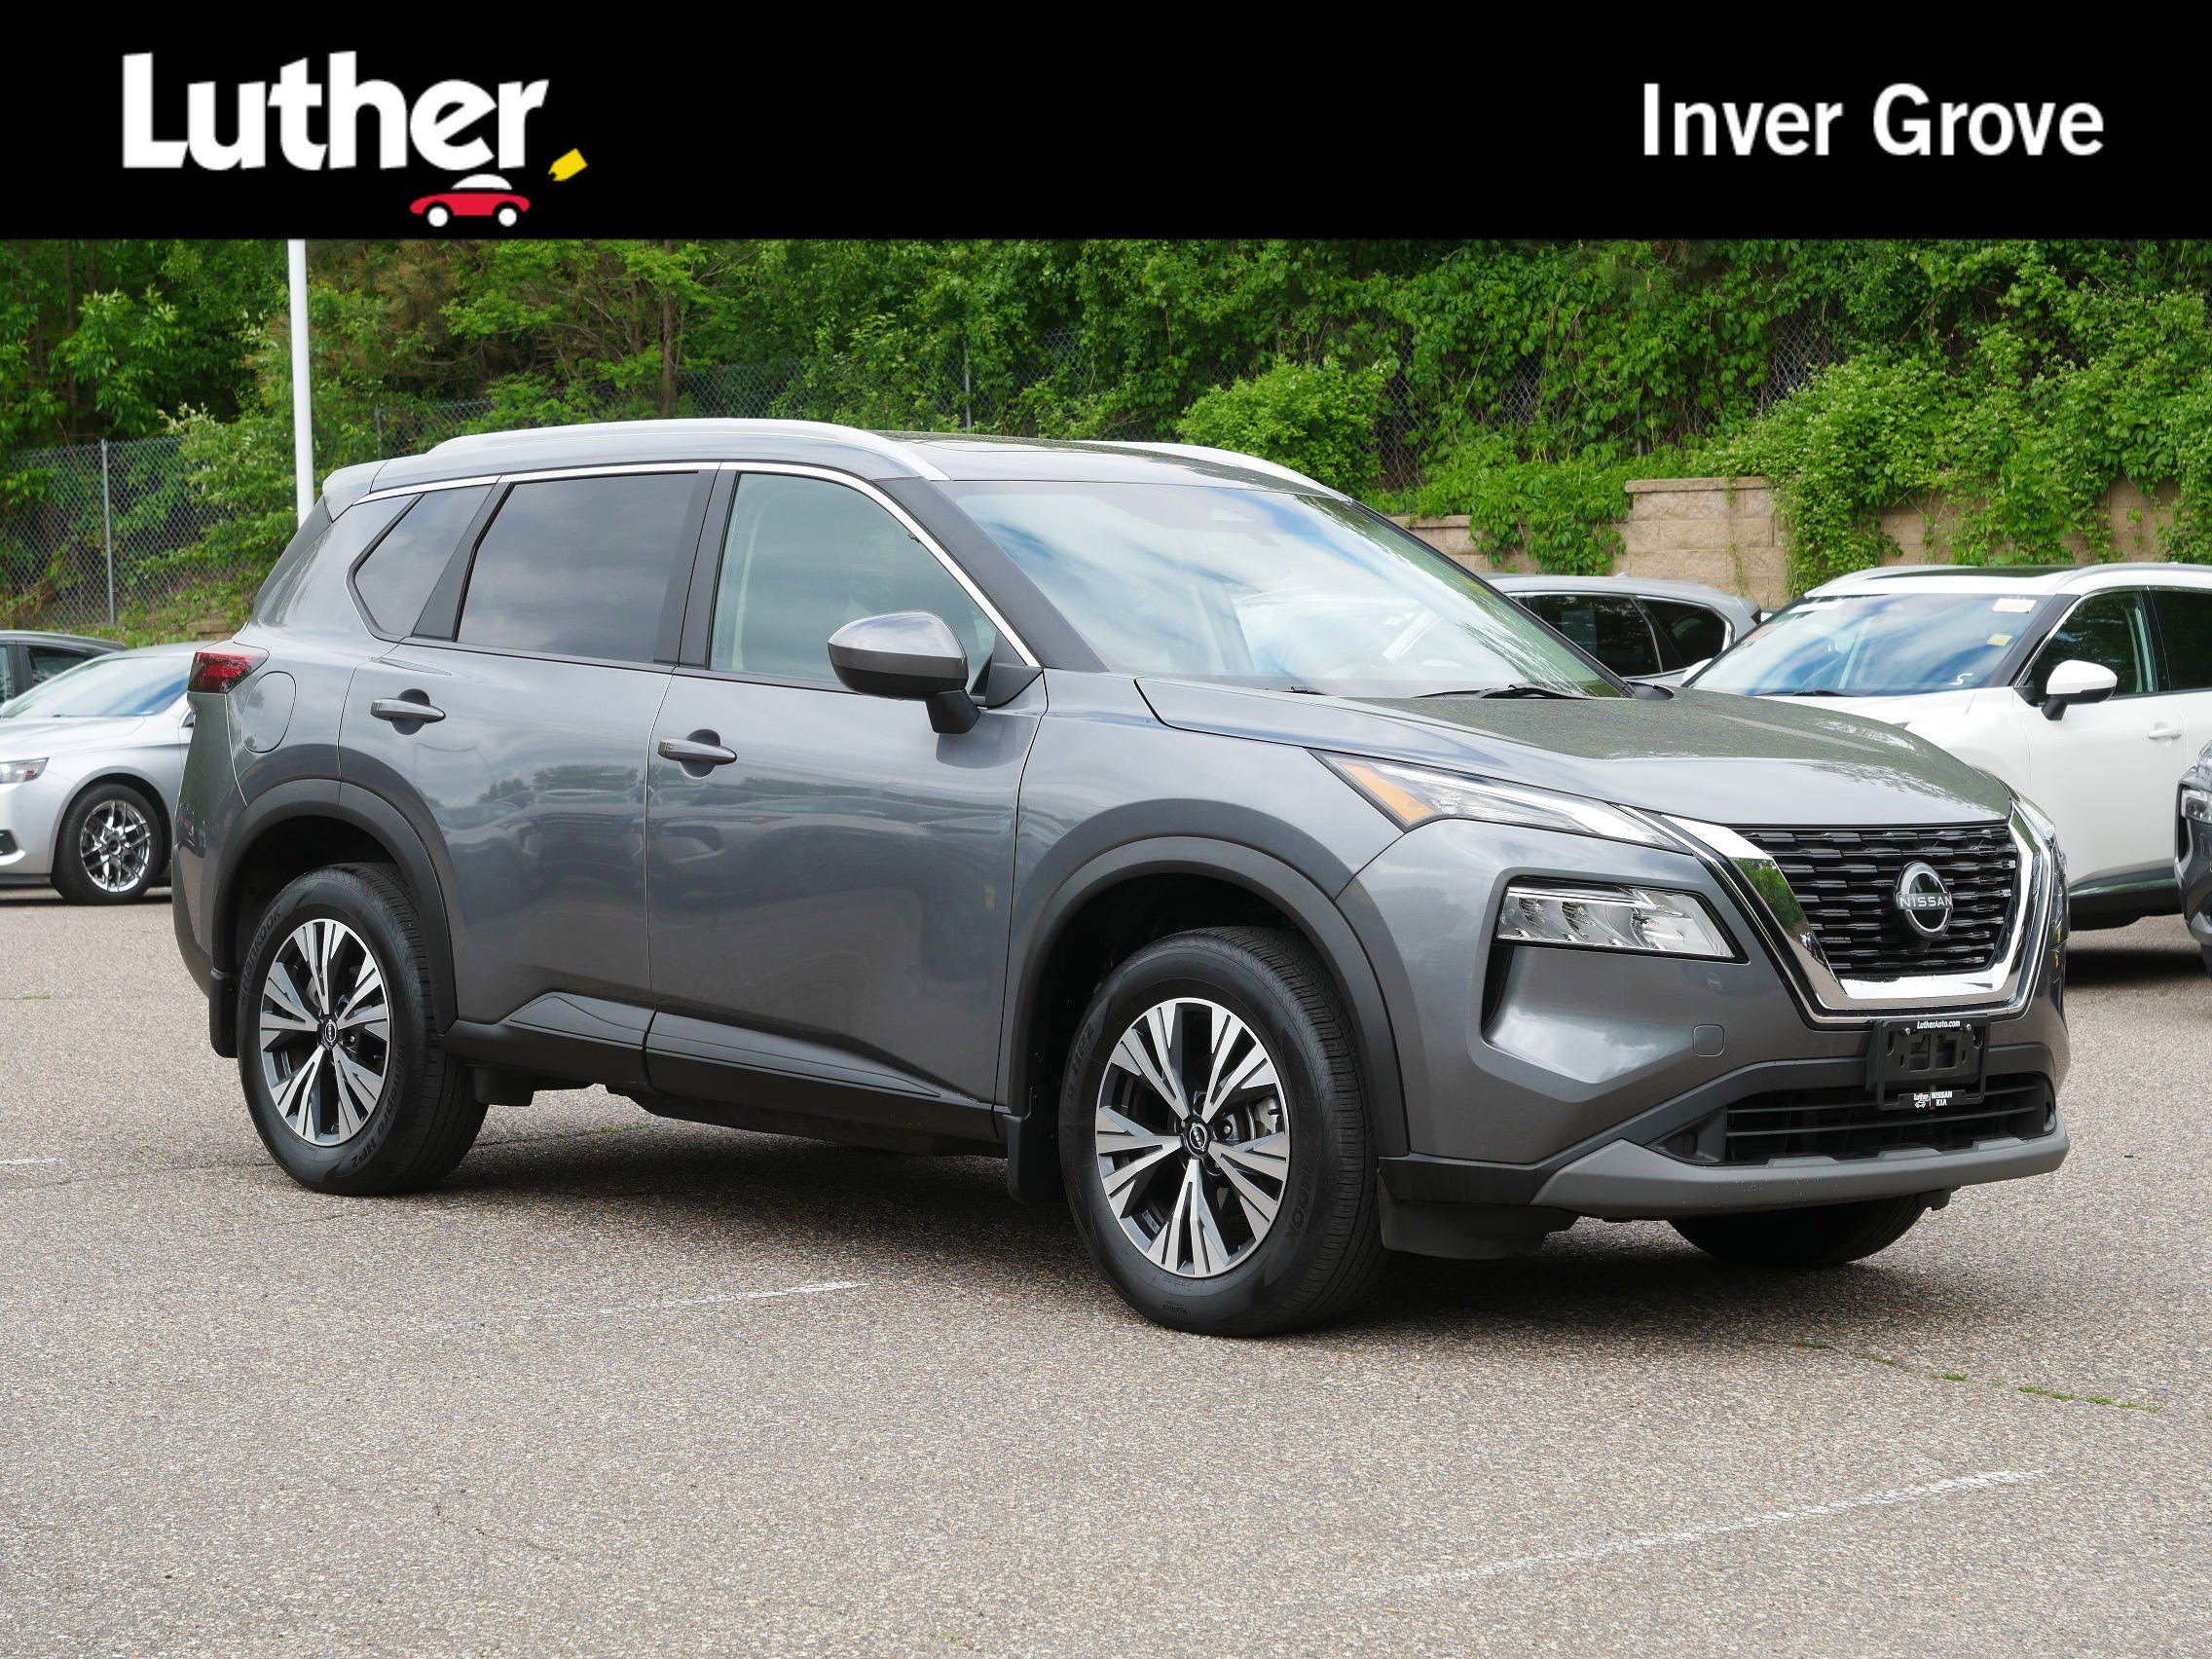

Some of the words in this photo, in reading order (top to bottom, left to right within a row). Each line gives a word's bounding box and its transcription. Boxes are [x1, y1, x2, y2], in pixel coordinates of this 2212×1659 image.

[1899, 896, 1953, 907] NISSAN
[1916, 1020, 1961, 1030] LutherAuto.com
[1931, 1090, 1953, 1099] NISSAN
[1936, 1098, 1947, 1107] KIA
